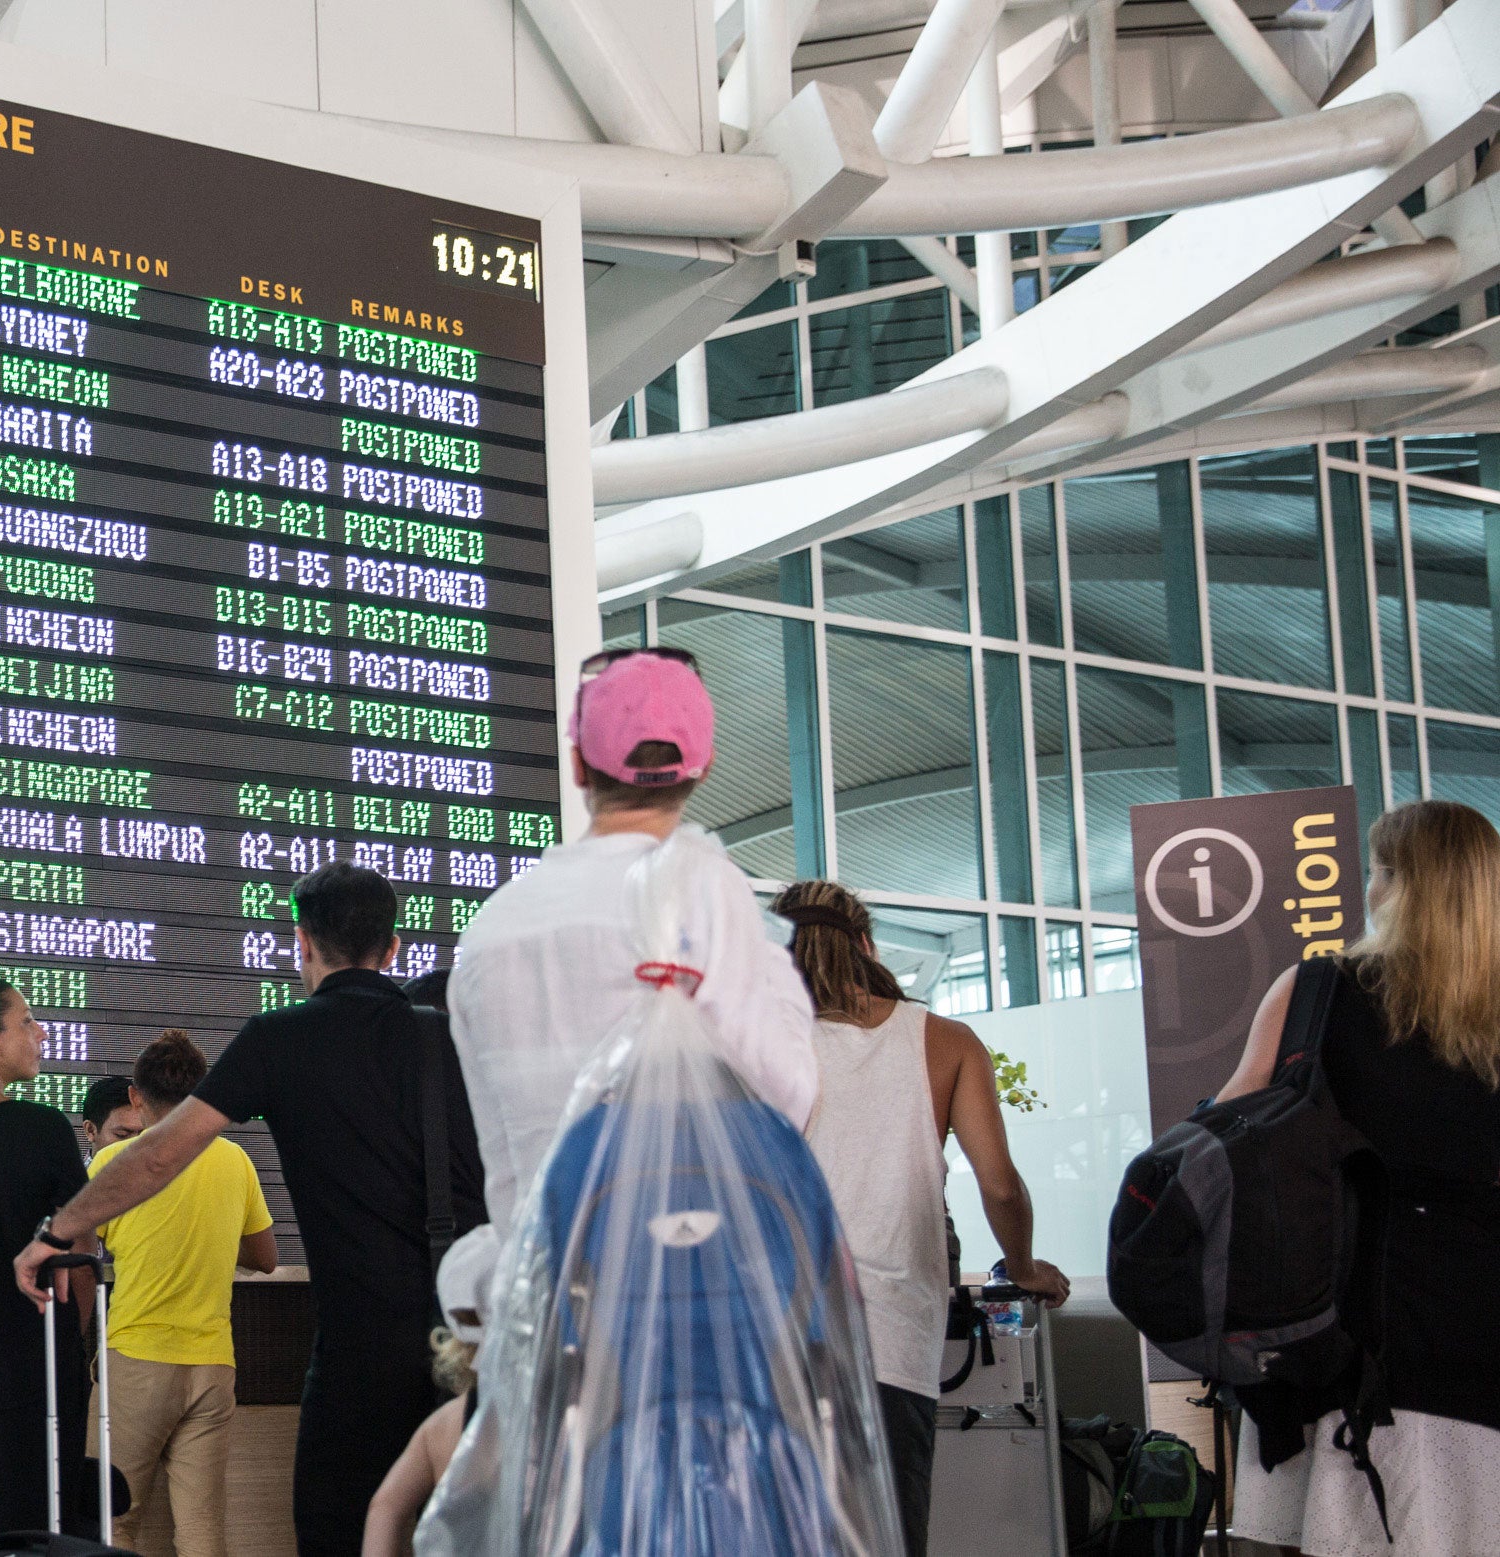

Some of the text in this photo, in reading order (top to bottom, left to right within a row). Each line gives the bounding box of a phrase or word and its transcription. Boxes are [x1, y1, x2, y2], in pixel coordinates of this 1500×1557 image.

[432, 233, 534, 290] 10:21
[241, 277, 302, 304] DESK
[352, 299, 463, 336] REMARKS
[209, 300, 323, 354] A13-A19
[338, 323, 477, 382] POSTPONED
[210, 347, 324, 400] A20-A23
[340, 370, 478, 427] POSTPONED
[342, 418, 480, 473] POSTPONED
[213, 442, 327, 492] A13-A18
[343, 464, 482, 519] POSTPONED
[214, 490, 325, 539] A19-A21
[345, 511, 484, 564] POSTPONED
[248, 543, 330, 588] B1-B5
[346, 556, 486, 609] POSTPONED
[216, 587, 331, 635] D13-D15
[348, 604, 487, 654] POSTPONED
[217, 635, 331, 683] B16-B24
[349, 651, 489, 701] POSTPONED
[236, 685, 334, 731] C7-C12
[350, 700, 490, 748] POSTPONED
[352, 748, 493, 795] POSTPONED
[239, 783, 335, 827] A2-A11
[353, 796, 430, 836] DELAY
[448, 806, 494, 842] BAD
[509, 812, 555, 848] WEA
[101, 818, 206, 864] LUMPUR
[355, 842, 432, 882] DELAY
[450, 851, 497, 888] BAD
